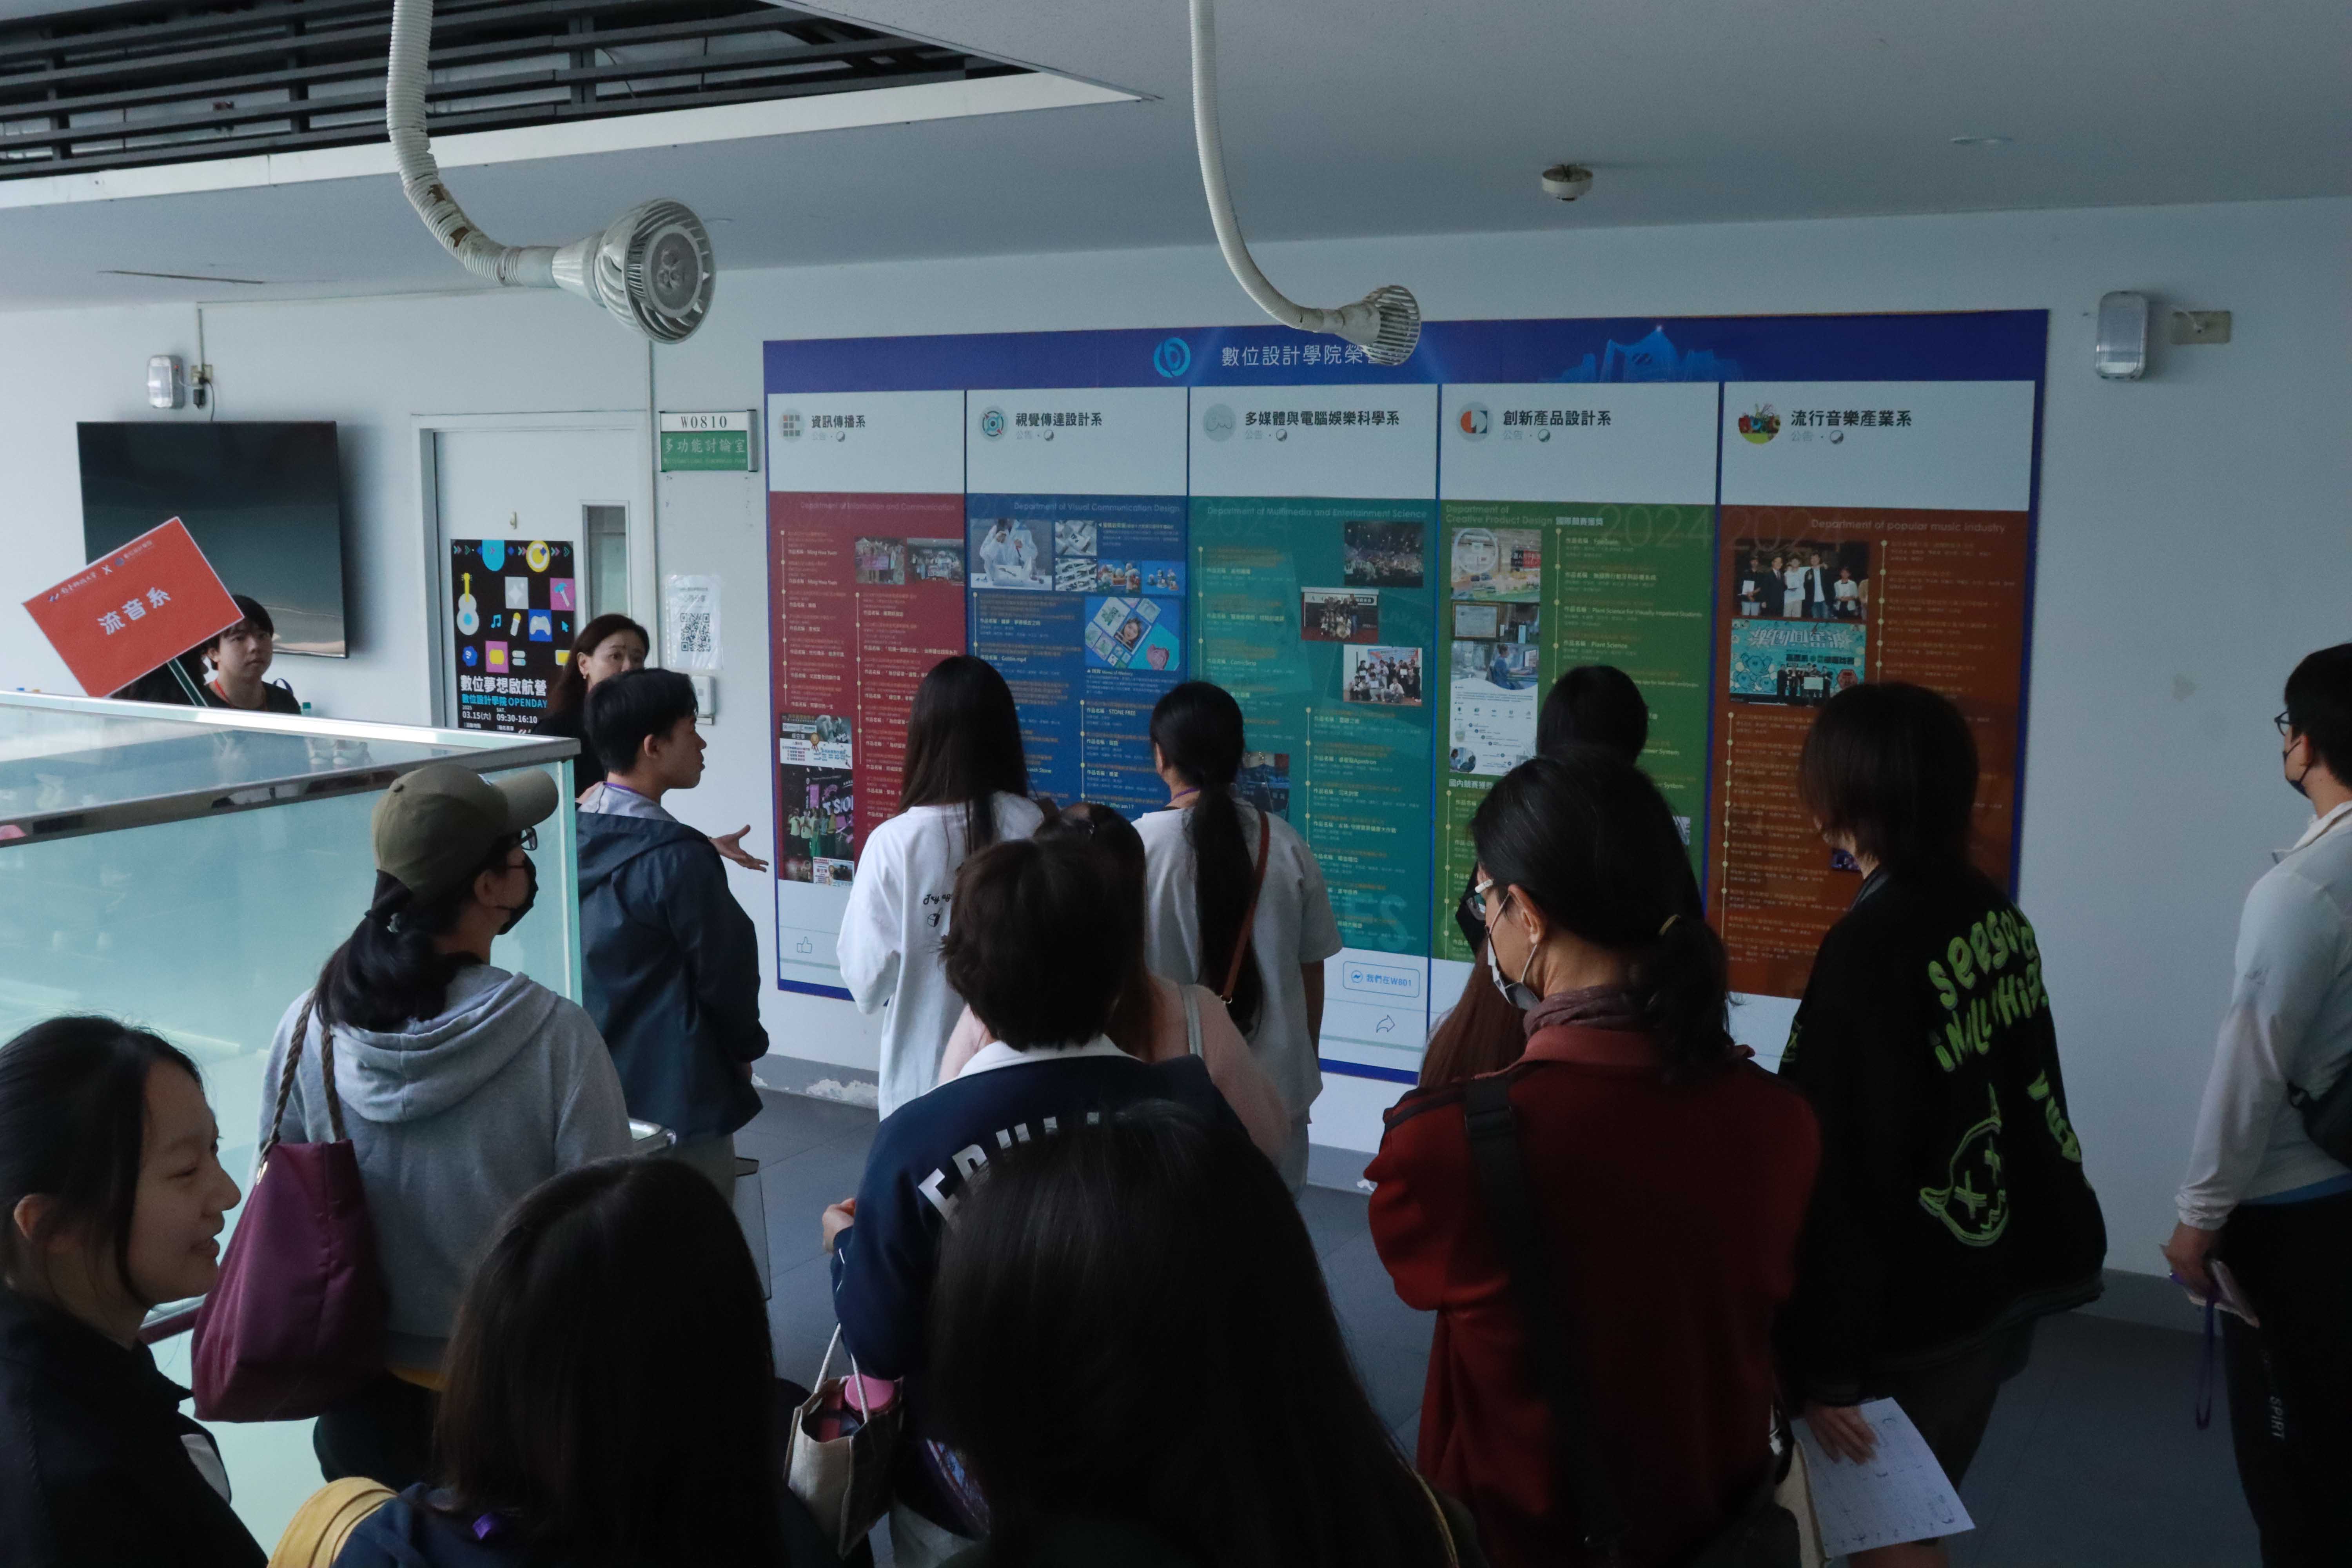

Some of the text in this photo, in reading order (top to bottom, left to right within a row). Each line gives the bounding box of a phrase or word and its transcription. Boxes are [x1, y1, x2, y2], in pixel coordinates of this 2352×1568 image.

[681, 416, 727, 428] W0810
[811, 414, 866, 428] 資訊傳播系
[1016, 412, 1102, 427] 視覺傳達設計系
[1245, 410, 1400, 426] 多媒體與電腦娛樂科學系
[1503, 410, 1611, 426] 創新產品設計系
[1791, 410, 1912, 426] 流行音樂產業系
[665, 438, 745, 454] 多功能討論室
[1014, 502, 1057, 511] Department
[1067, 503, 1090, 511] Visual
[1091, 503, 1152, 512] Communication
[1154, 504, 1180, 514] Design
[1207, 506, 1254, 515] Department
[1257, 507, 1265, 515] of
[1266, 508, 1312, 517] Multimedia
[1332, 509, 1391, 518] Entertainment
[1392, 510, 1427, 518] Science
[1446, 504, 1509, 515] Department of
[1445, 514, 1553, 526] Creative Product Design
[1811, 518, 2005, 534] Department of popular music industry
[97, 587, 171, 635] 流音系
[460, 675, 547, 697] 數位夢想啟航營
[508, 697, 548, 708] OPENDAY
[462, 711, 491, 720] 03.15(六)
[496, 714, 537, 724] 09:30-16:10
[923, 894, 940, 905] Try
[1366, 974, 1412, 987] 我們在W801
